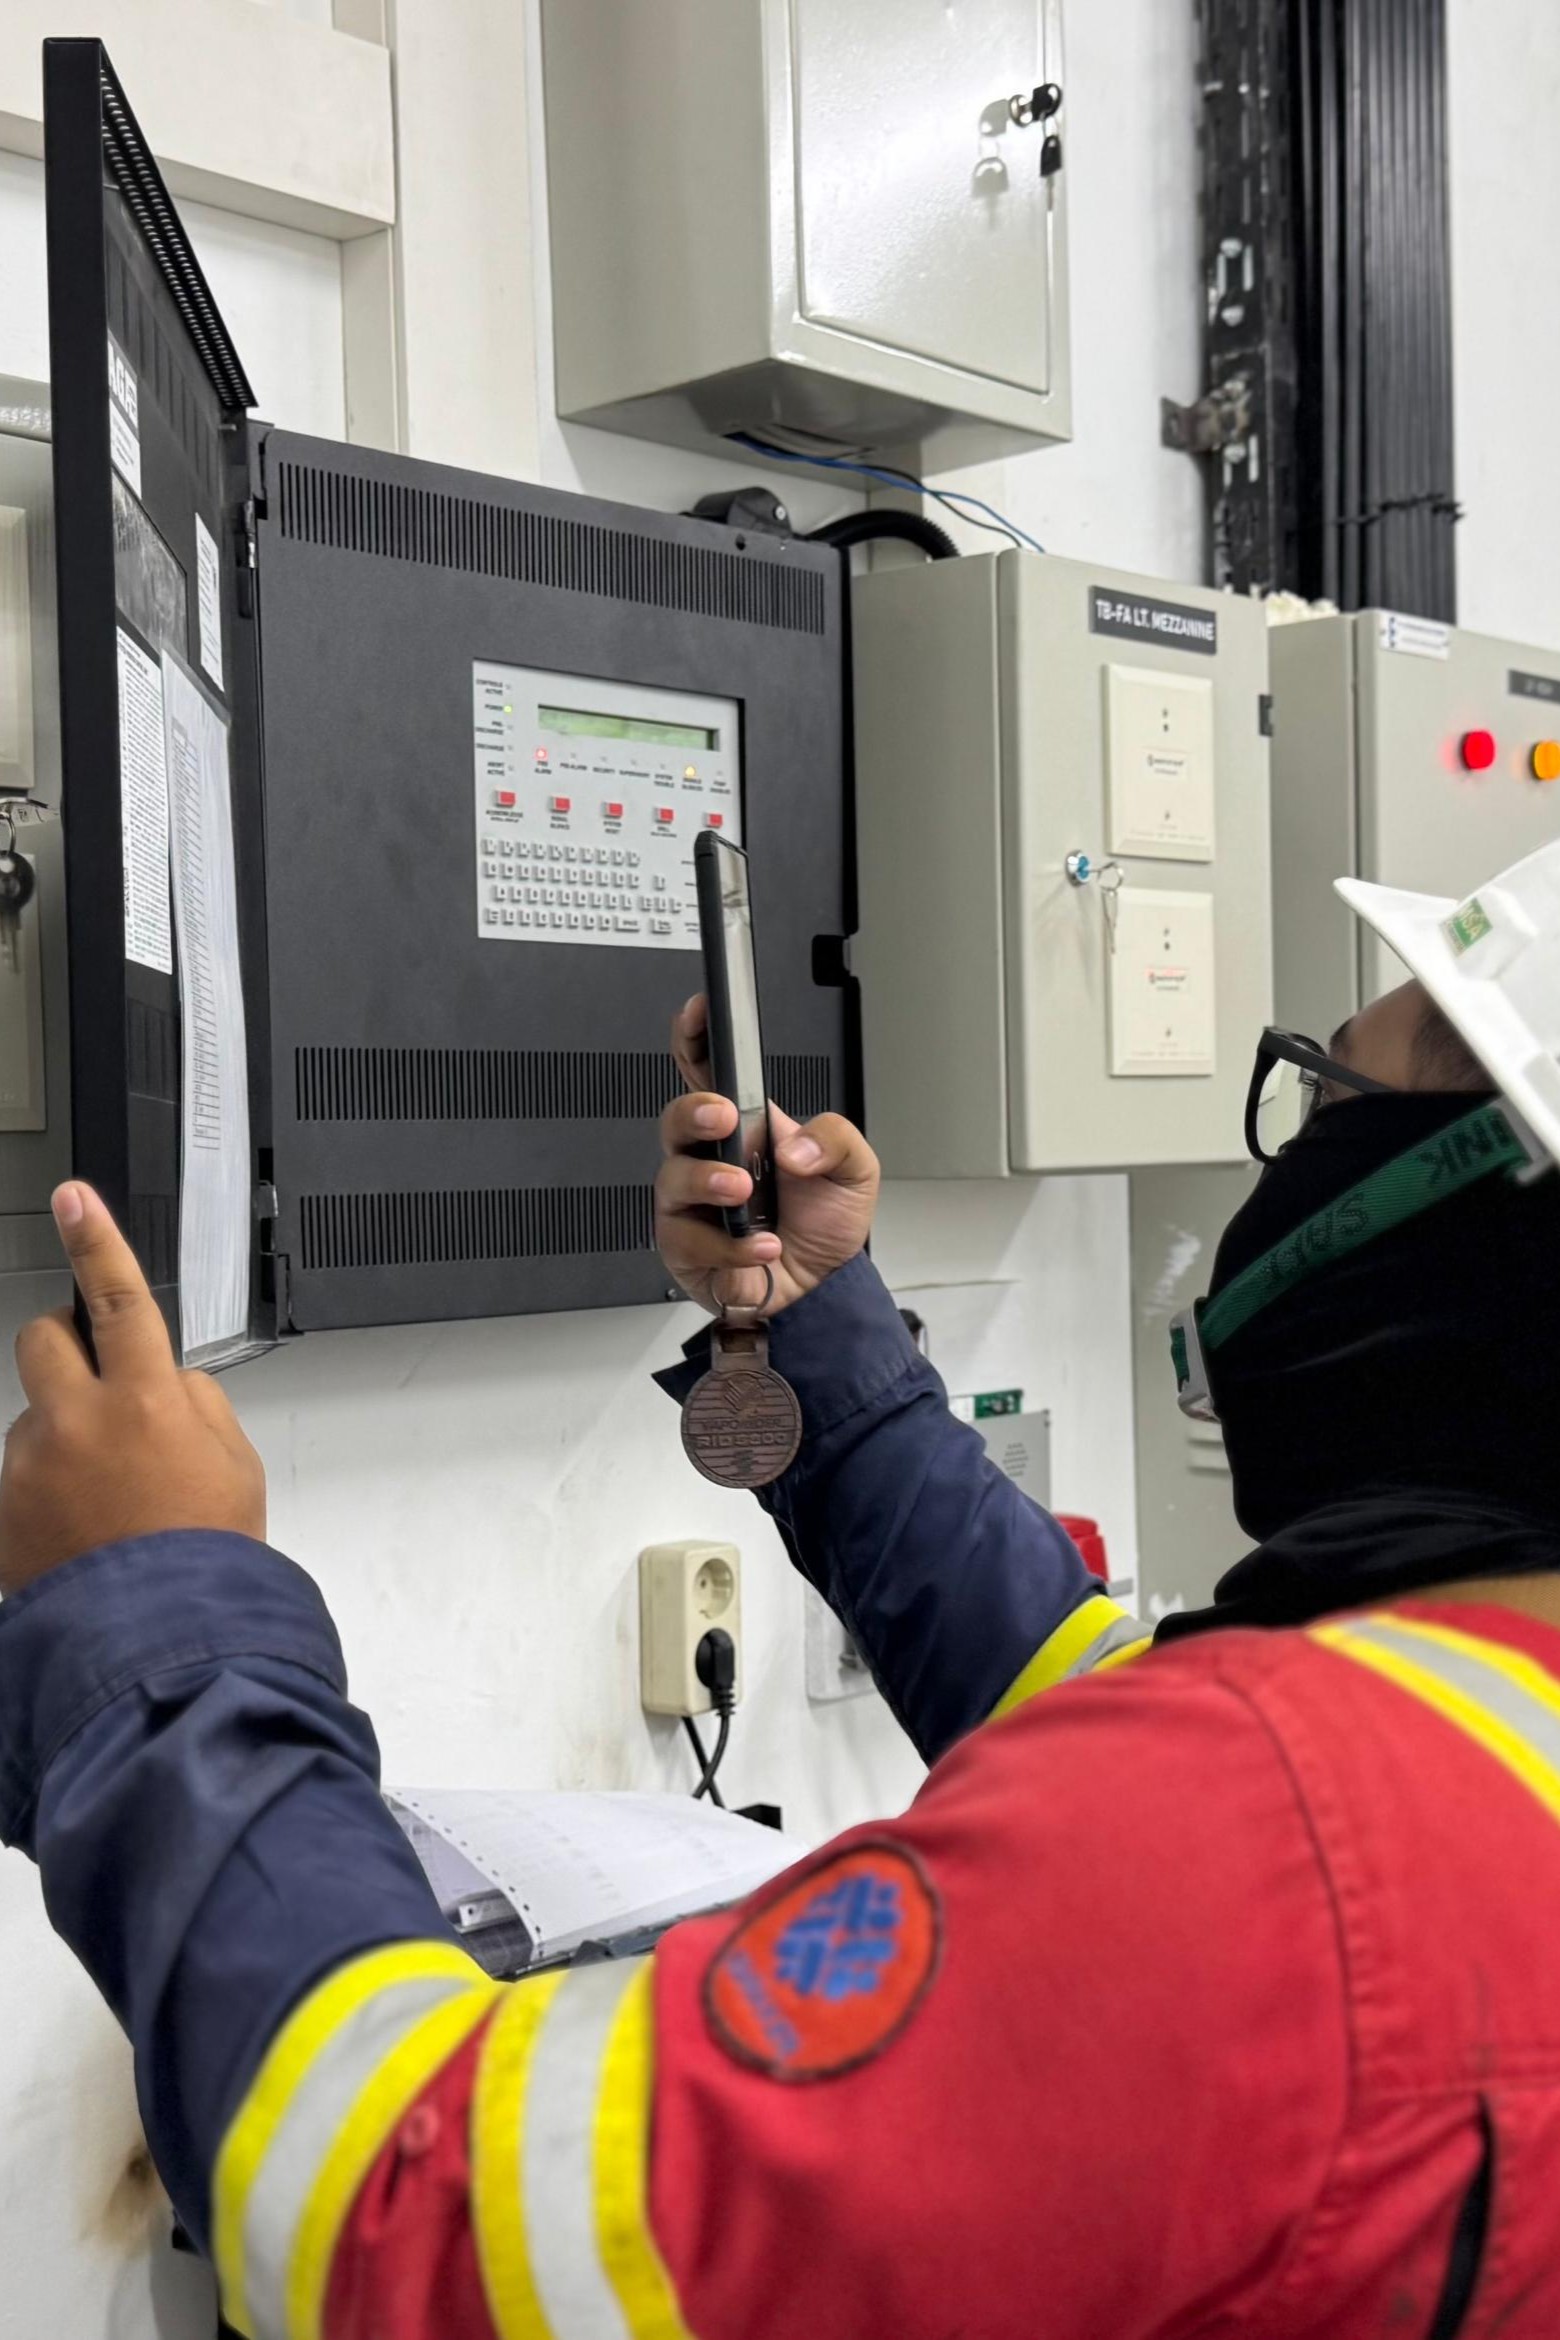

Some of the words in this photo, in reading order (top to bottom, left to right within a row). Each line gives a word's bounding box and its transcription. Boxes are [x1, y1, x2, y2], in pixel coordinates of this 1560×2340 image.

[1096, 599, 1131, 624] TB-FA
[1133, 607, 1150, 628] LT.
[1152, 610, 1214, 641] MEZZANINE
